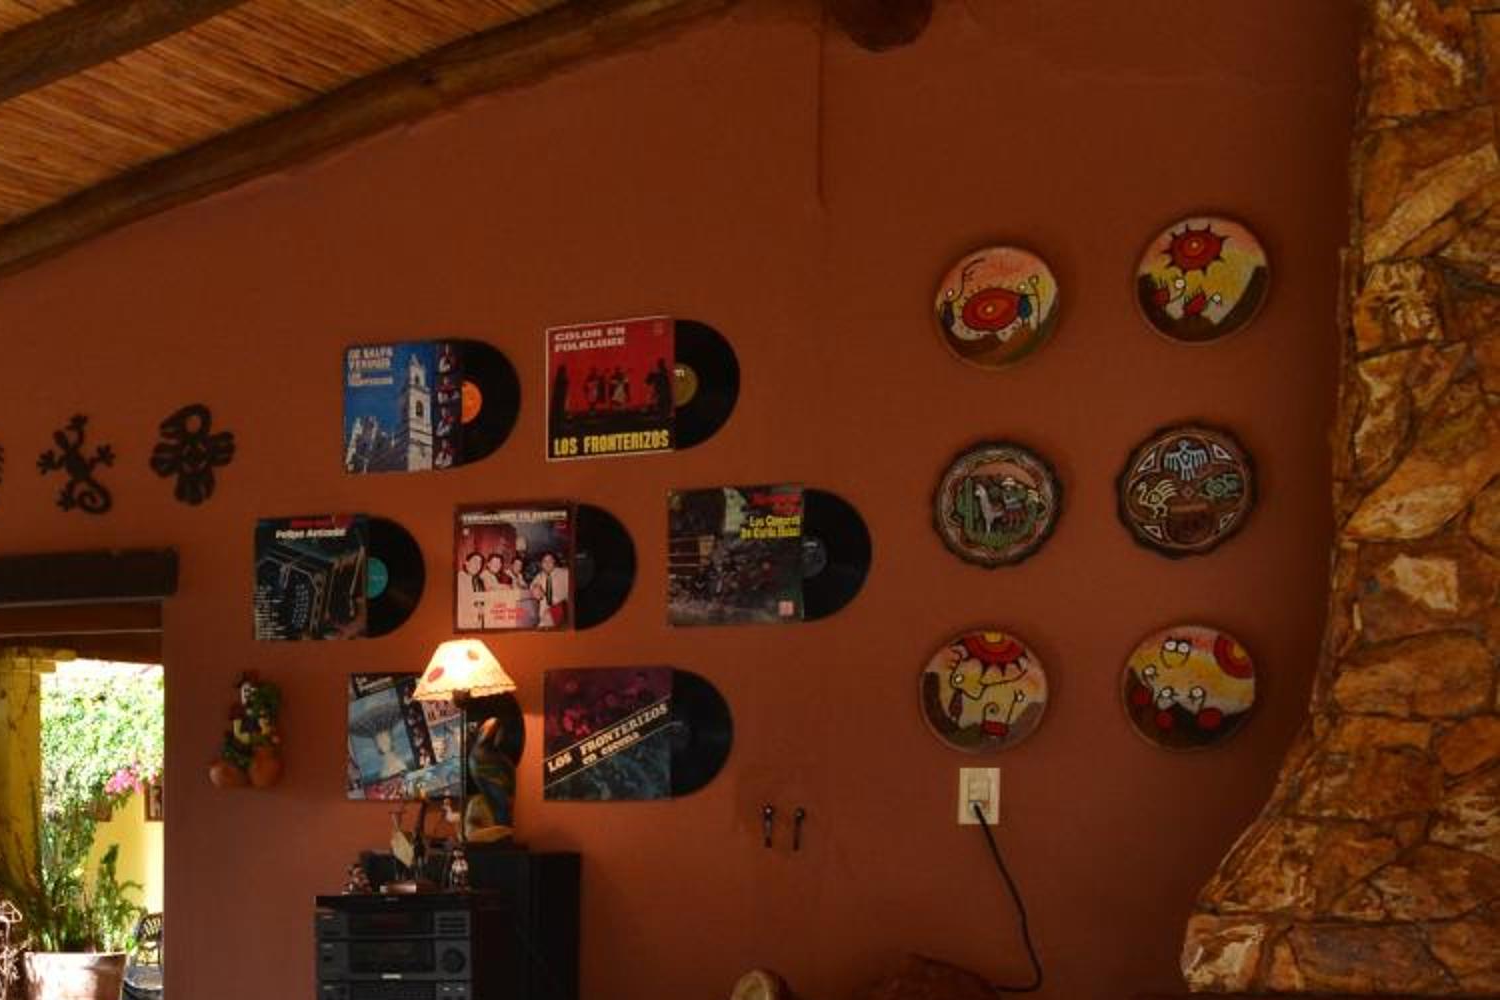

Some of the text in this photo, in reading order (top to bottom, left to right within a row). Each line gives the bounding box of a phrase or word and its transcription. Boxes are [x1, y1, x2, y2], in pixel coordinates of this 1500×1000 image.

[554, 326, 626, 341] COLOR EN
[554, 336, 626, 353] FOLKLORE
[553, 429, 669, 457] LOS FRONTERIZOS
[547, 703, 668, 772] LOS FRONTERIZOS
